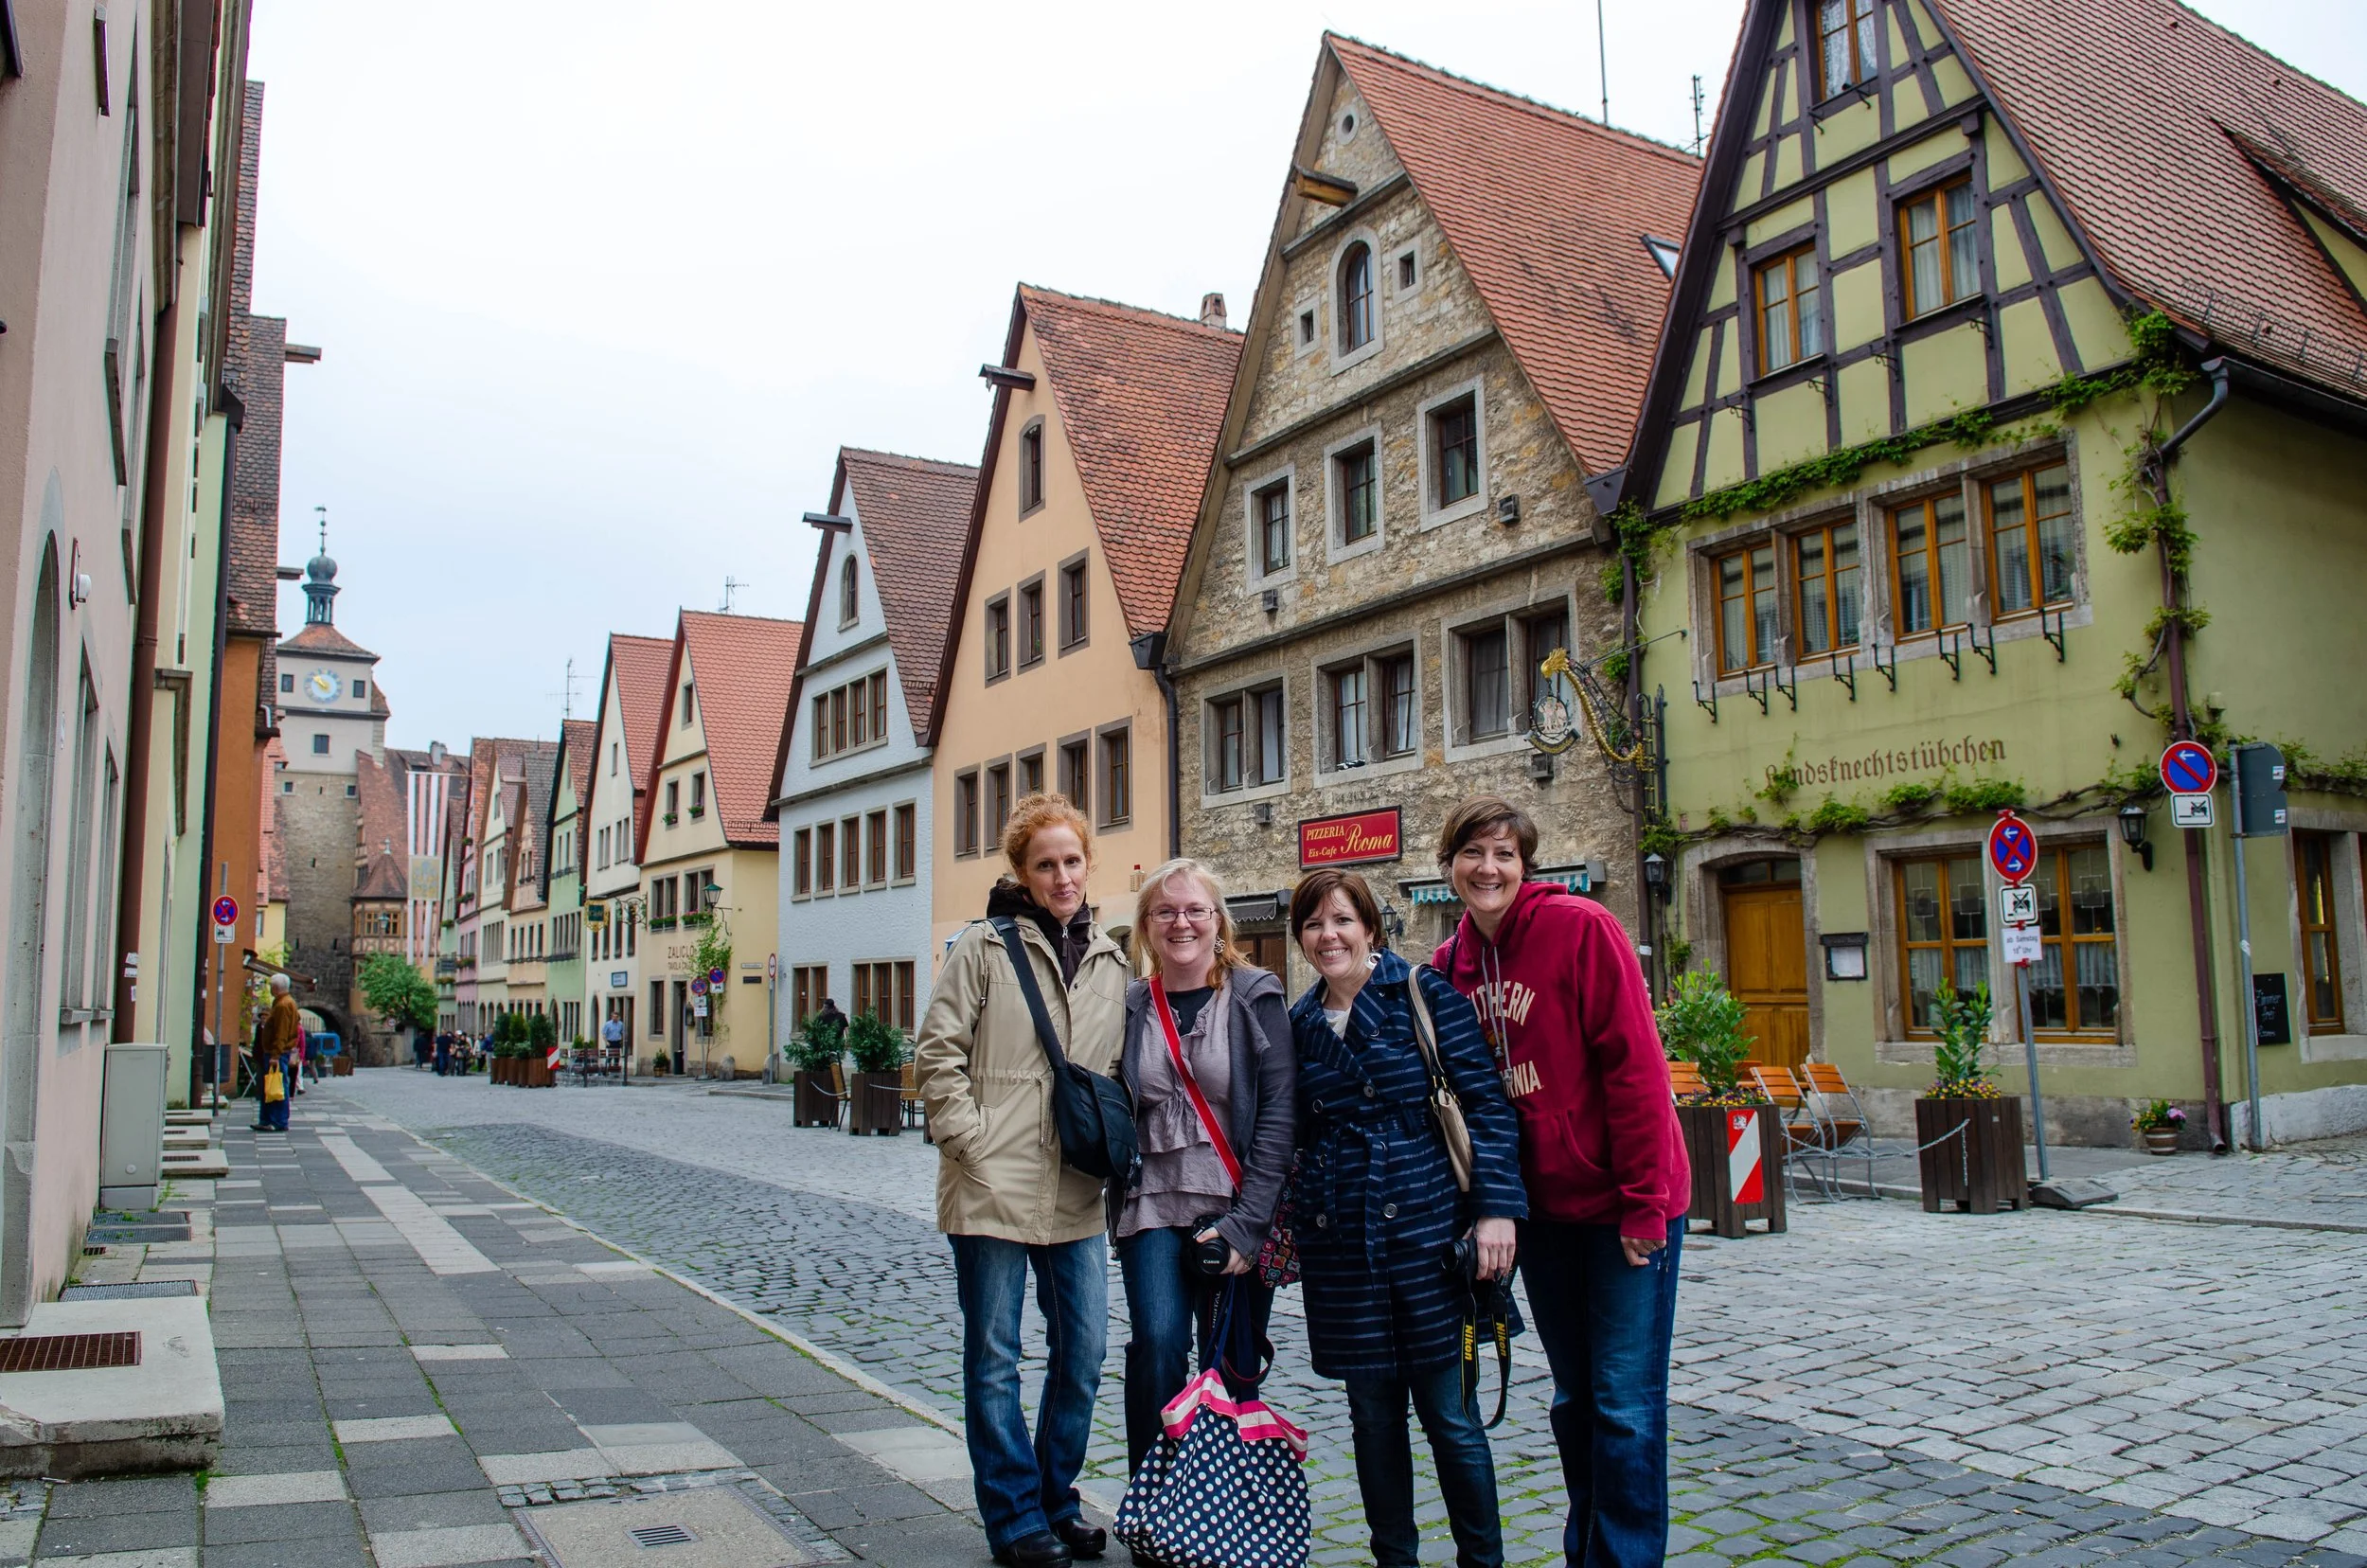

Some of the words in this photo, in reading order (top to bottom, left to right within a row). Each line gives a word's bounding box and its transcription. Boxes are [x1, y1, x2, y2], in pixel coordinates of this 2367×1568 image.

[1765, 735, 2006, 788] Lndsknechtstübchen
[1307, 825, 1344, 841] PIZZERIA
[1341, 823, 1394, 853] Roma
[1465, 1324, 1473, 1362] Nikon
[1495, 1322, 1506, 1357] Nikon
